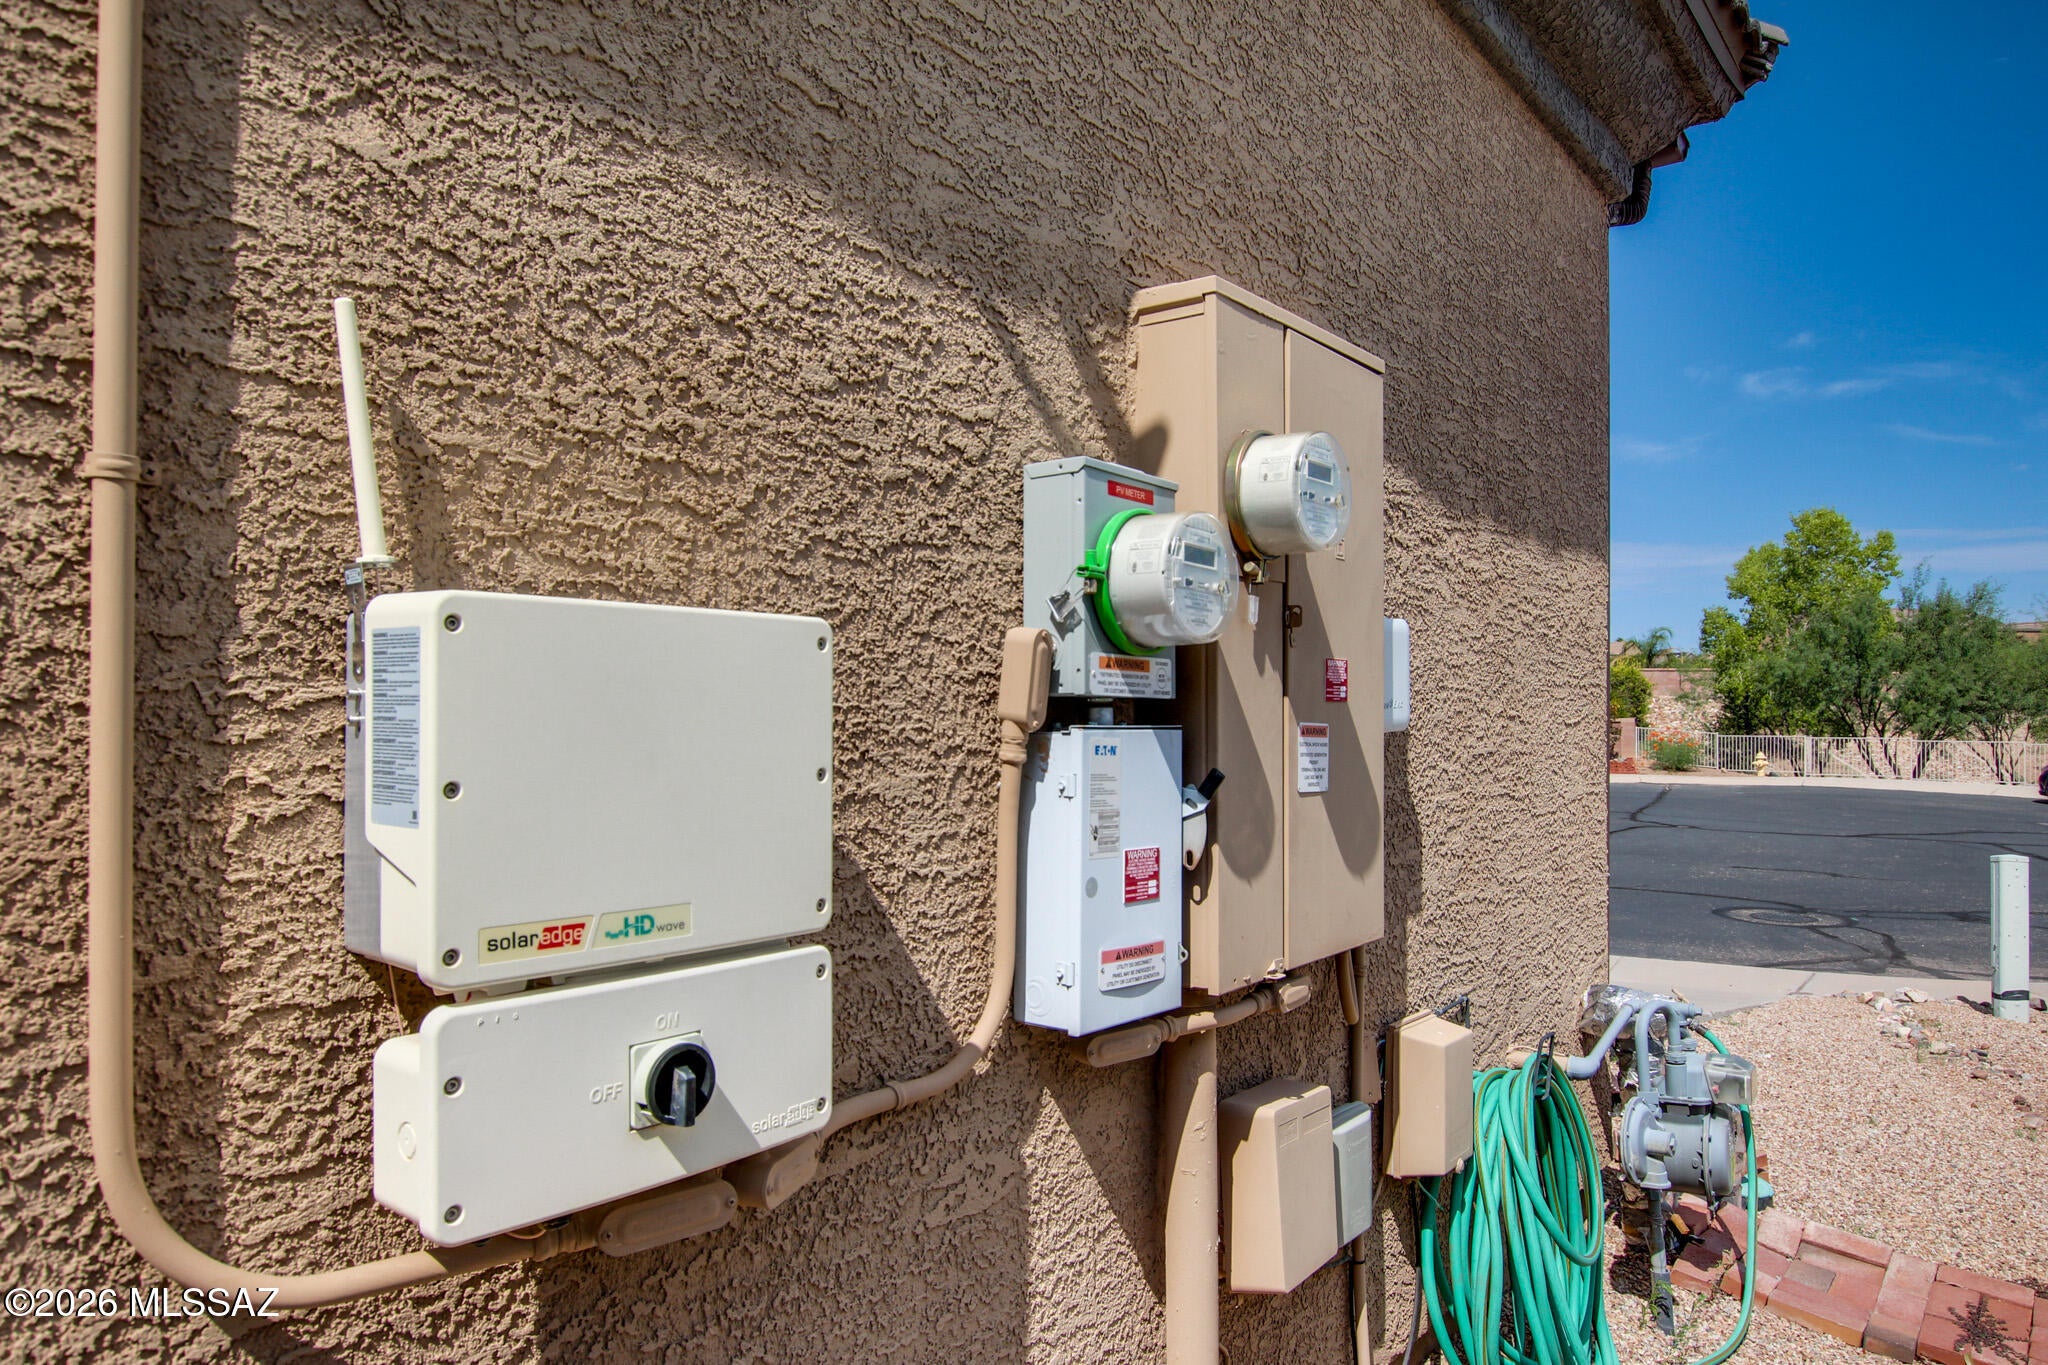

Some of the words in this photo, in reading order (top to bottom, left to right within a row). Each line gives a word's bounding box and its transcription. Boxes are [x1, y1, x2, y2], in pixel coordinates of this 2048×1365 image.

[1115, 485, 1125, 495] PV
[1125, 487, 1146, 500] METER
[1114, 657, 1145, 670] WARNING
[1304, 727, 1327, 736] WARNING
[1127, 848, 1158, 860] WARNING
[656, 921, 686, 932] wave
[487, 926, 584, 952] solaredge
[1122, 944, 1154, 959] WARNING
[655, 1011, 680, 1031] ON
[590, 1081, 625, 1104] OFF
